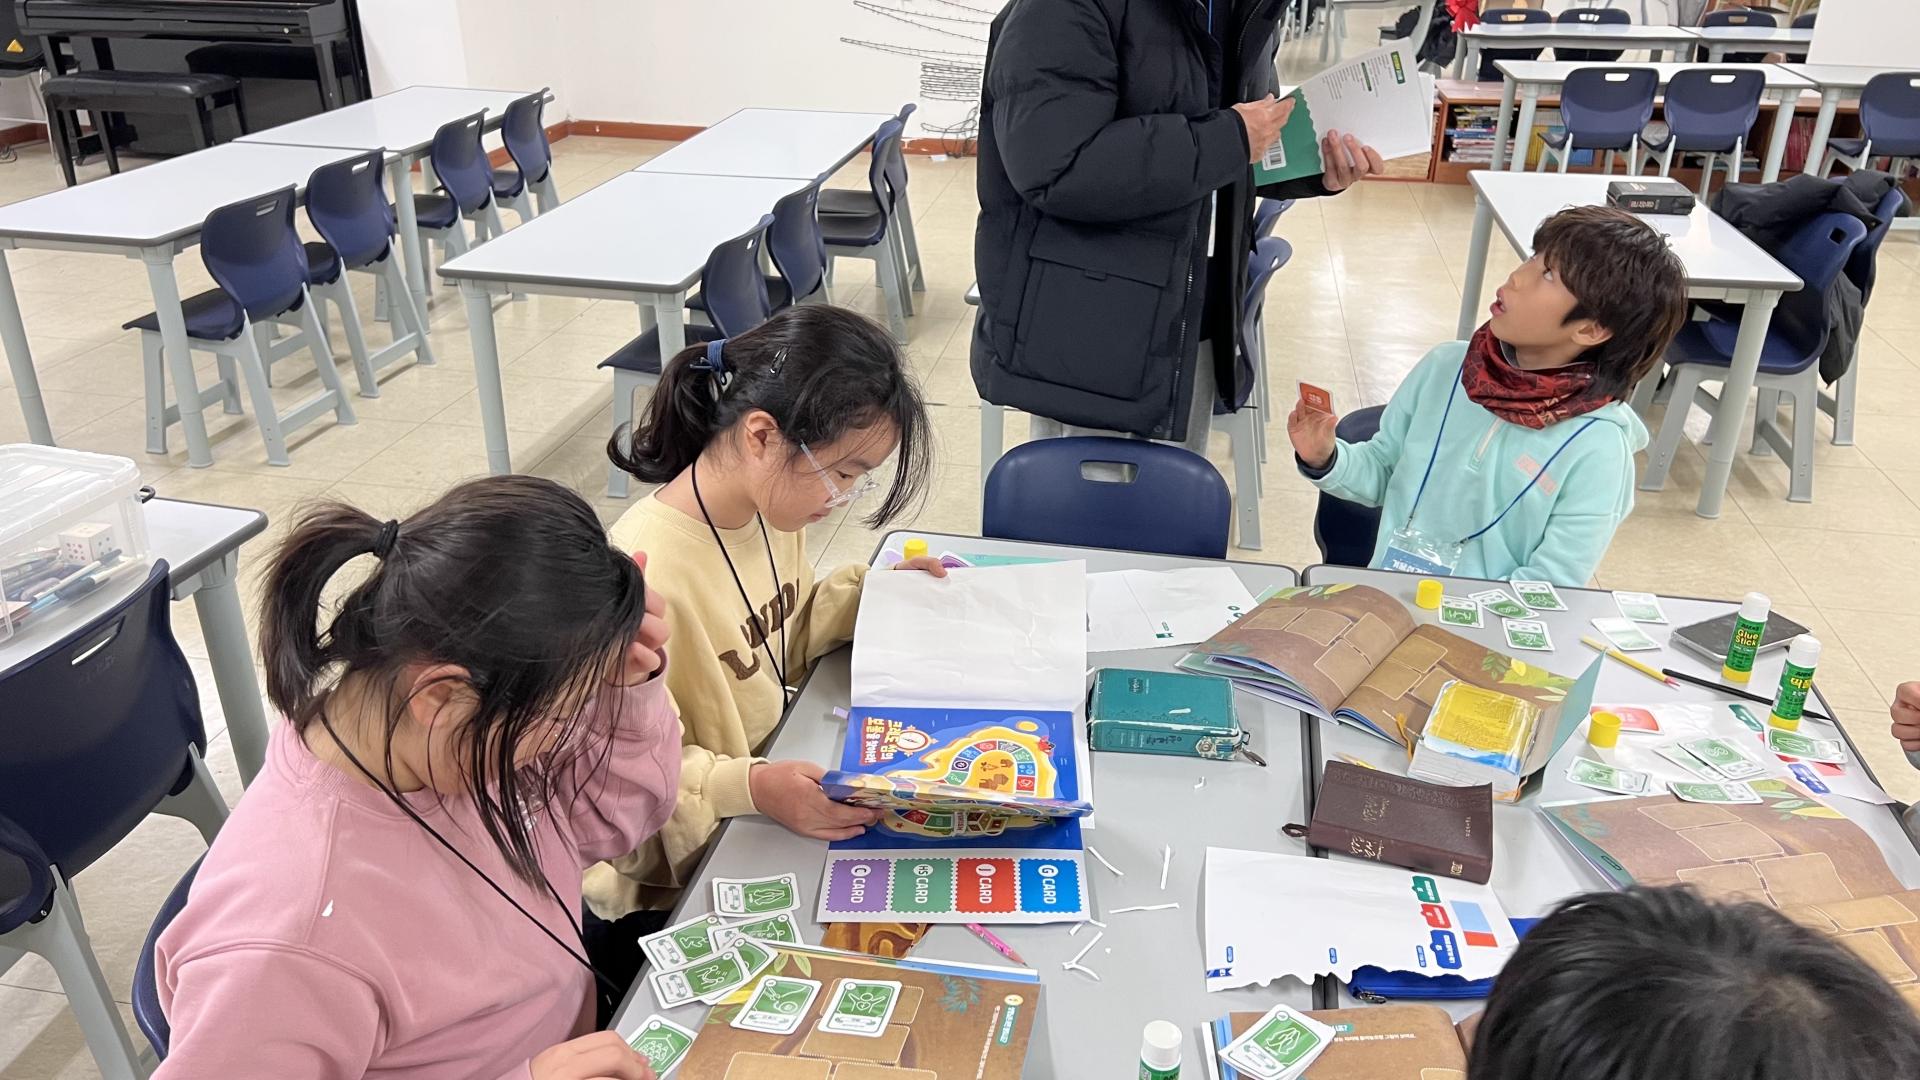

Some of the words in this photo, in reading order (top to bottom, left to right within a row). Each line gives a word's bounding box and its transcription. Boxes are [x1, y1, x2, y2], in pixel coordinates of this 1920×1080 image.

[1735, 635, 1756, 646] Stick
[1737, 629, 1759, 639] Glue
[865, 716, 885, 740] 보물을
[850, 877, 866, 904] CARD
[915, 877, 929, 904] CARD
[979, 877, 993, 904] CARD
[1042, 877, 1057, 905] CARD
